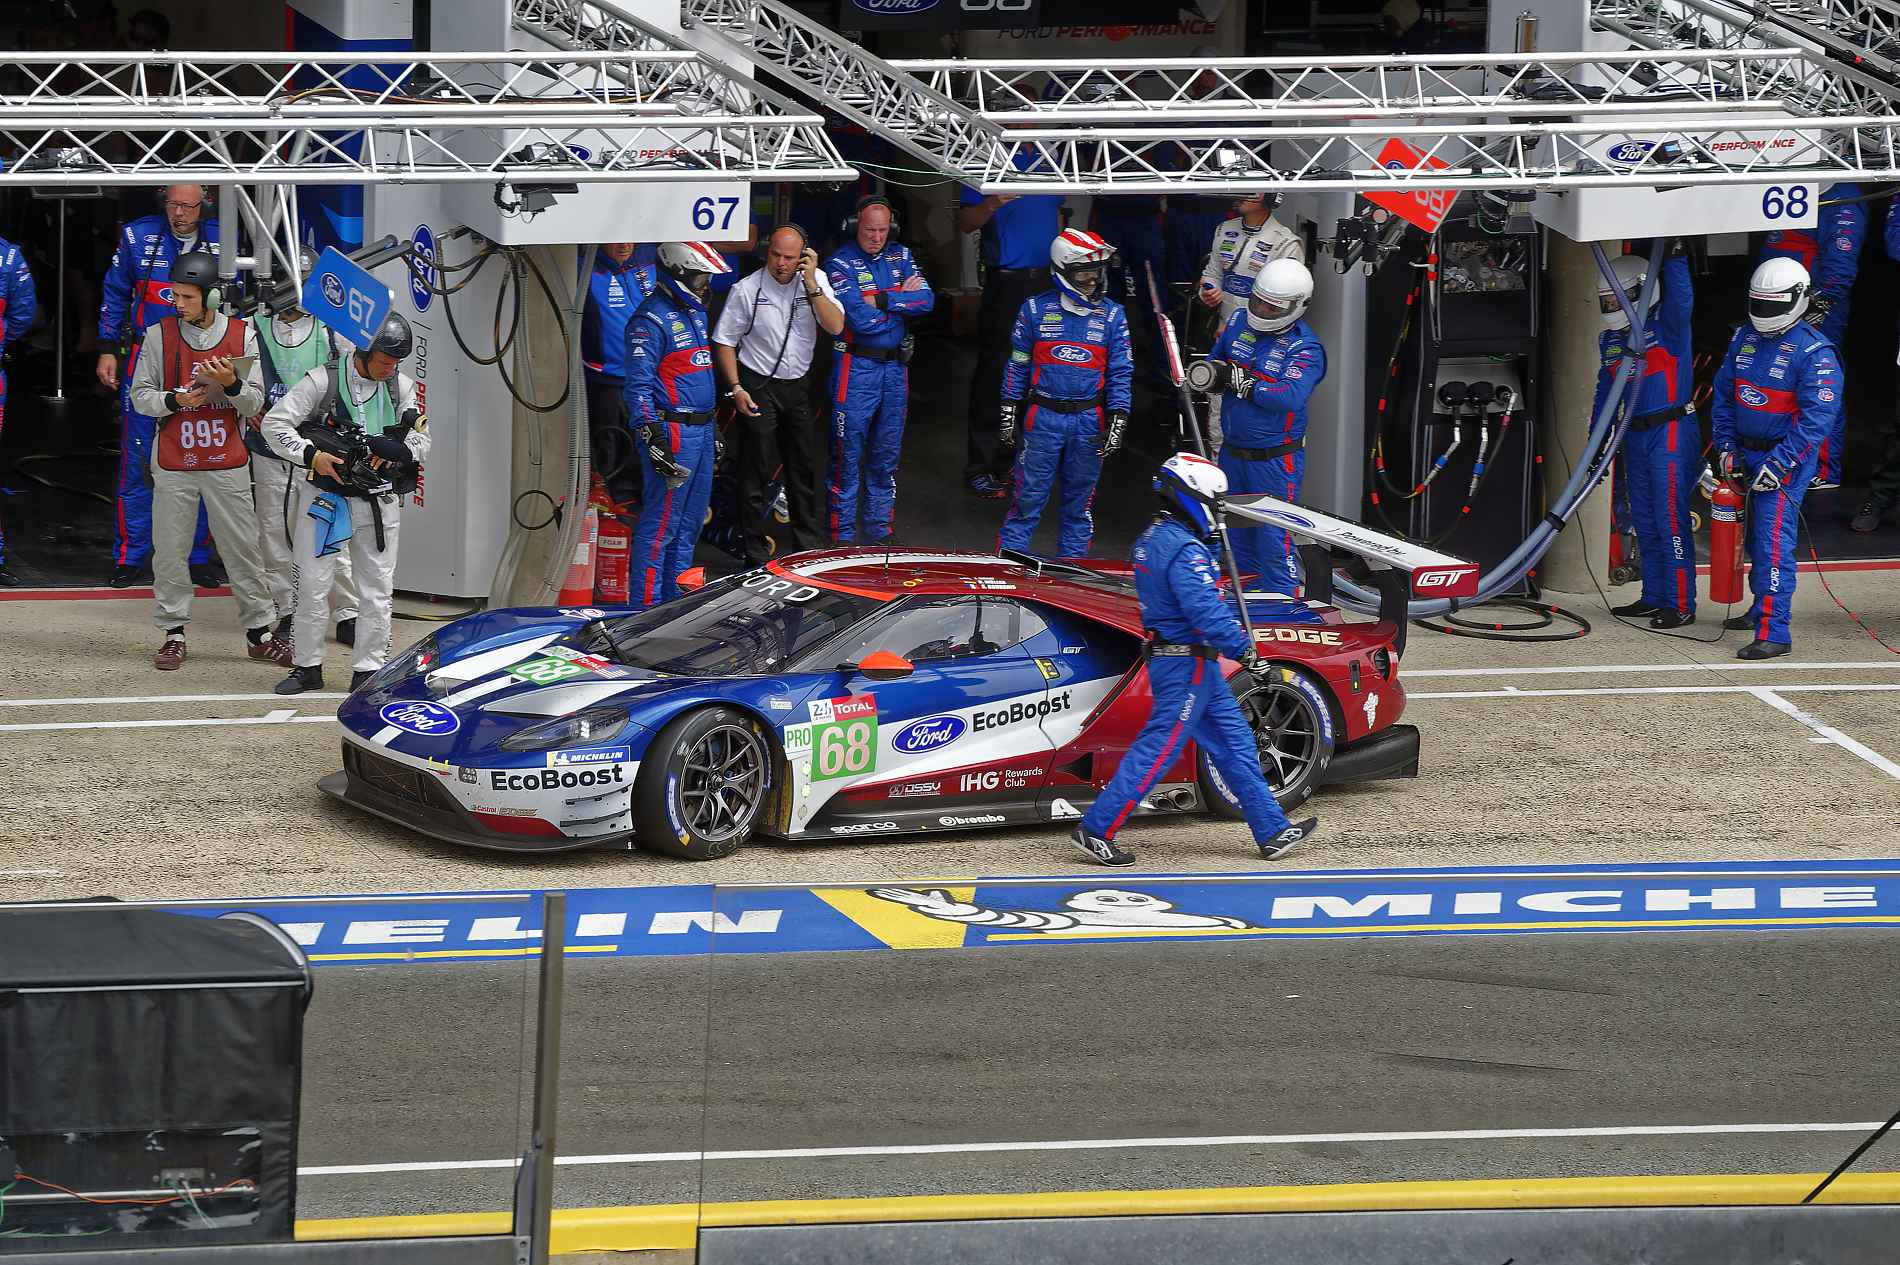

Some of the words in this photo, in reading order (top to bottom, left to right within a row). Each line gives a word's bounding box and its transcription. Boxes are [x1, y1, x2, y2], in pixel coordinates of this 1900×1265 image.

[998, 26, 1050, 39] FORD
[1711, 138, 1796, 152] PERFORMNCE
[692, 196, 740, 230] 67
[1762, 185, 1808, 220] 68
[349, 287, 375, 329] 67
[415, 335, 428, 379] FORD
[1058, 346, 1087, 361] Ford
[180, 419, 227, 449] 895
[1338, 531, 1393, 553] Powered
[1672, 536, 1685, 560] FORD
[792, 555, 841, 569] FORD
[1283, 555, 1299, 578] FORD
[1416, 569, 1478, 587] GT
[1769, 567, 1780, 592] FORD
[1254, 628, 1343, 645] EDGE
[388, 703, 448, 731] Ford
[834, 702, 874, 715] TOTAL
[973, 690, 1071, 732] EcoBoost
[1302, 680, 1332, 739] MICHELIN
[786, 727, 811, 749] PRO
[906, 720, 953, 749] Ford
[570, 751, 624, 762] MICHELIN
[820, 722, 871, 776] 68
[490, 763, 624, 791] EcoBoost
[960, 771, 1000, 792] IHG
[1005, 766, 1043, 779] Rewards
[1004, 777, 1026, 788] Club
[477, 804, 497, 813] Castrol
[956, 814, 1006, 825] brembo
[830, 821, 897, 834] sparco
